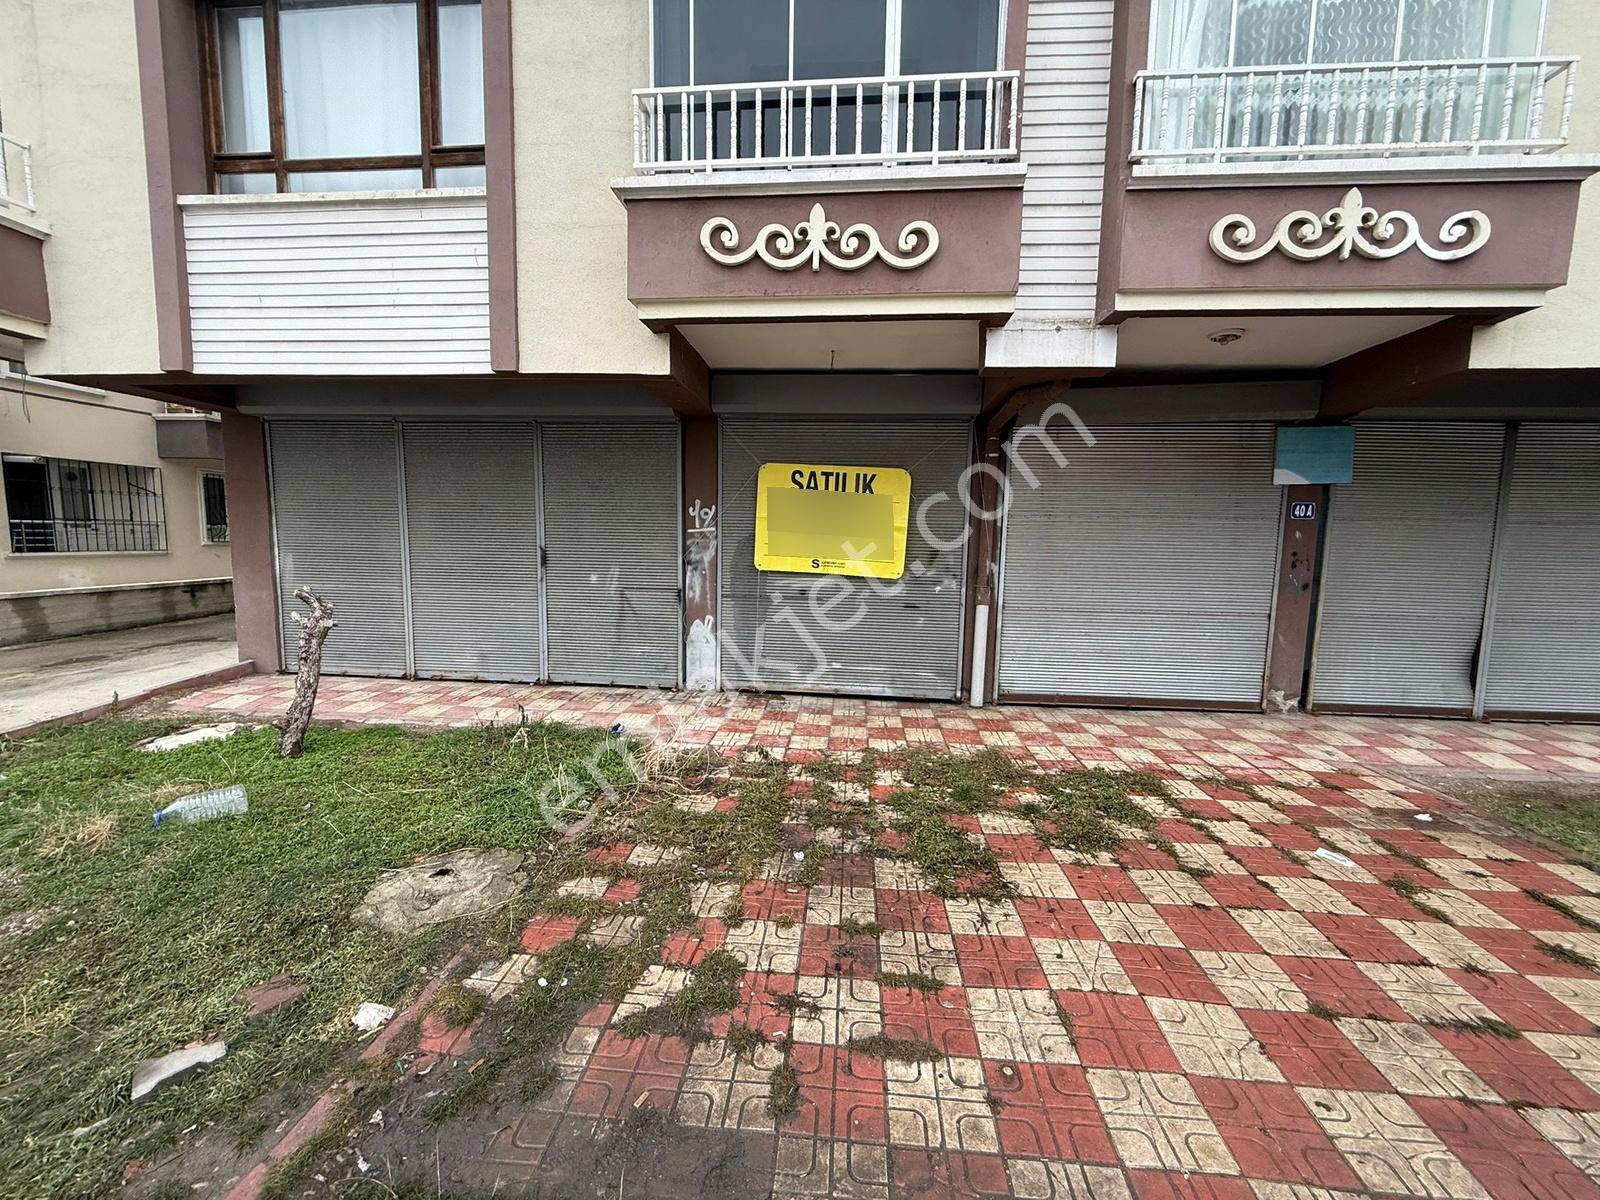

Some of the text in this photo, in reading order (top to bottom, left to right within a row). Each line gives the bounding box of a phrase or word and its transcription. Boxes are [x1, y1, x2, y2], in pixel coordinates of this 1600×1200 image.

[1294, 504, 1312, 517] 40 A
[811, 559, 820, 569] S
